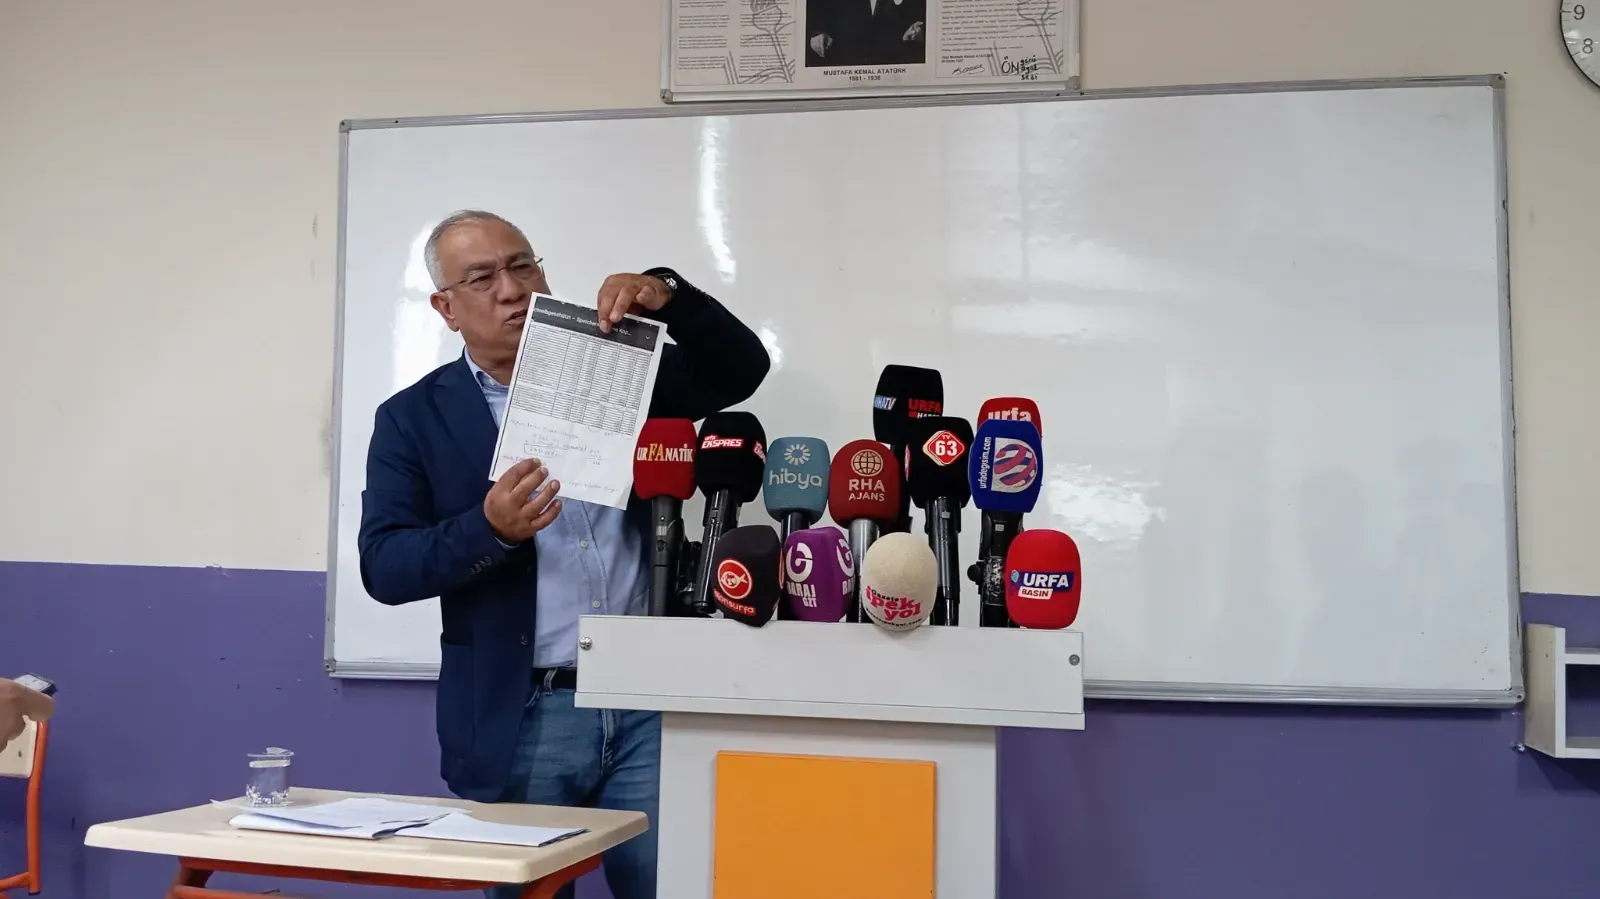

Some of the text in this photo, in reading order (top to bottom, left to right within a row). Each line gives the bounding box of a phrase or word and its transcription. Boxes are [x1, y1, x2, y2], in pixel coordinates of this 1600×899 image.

[1573, 4, 1586, 21] 9
[1582, 37, 1594, 55] 8
[908, 398, 942, 414] URFA
[988, 407, 1031, 422] urfa
[701, 438, 744, 449] EKSPRES
[935, 440, 957, 456] 63
[768, 467, 822, 489] hibya
[848, 478, 886, 492] RHA
[848, 491, 885, 502] AJANS
[1023, 572, 1069, 588] URFA
[865, 585, 916, 609] ipek
[871, 589, 900, 602] Gazete
[1021, 588, 1049, 598] BASIN
[802, 597, 818, 608] GZT
[883, 601, 922, 622] yol
